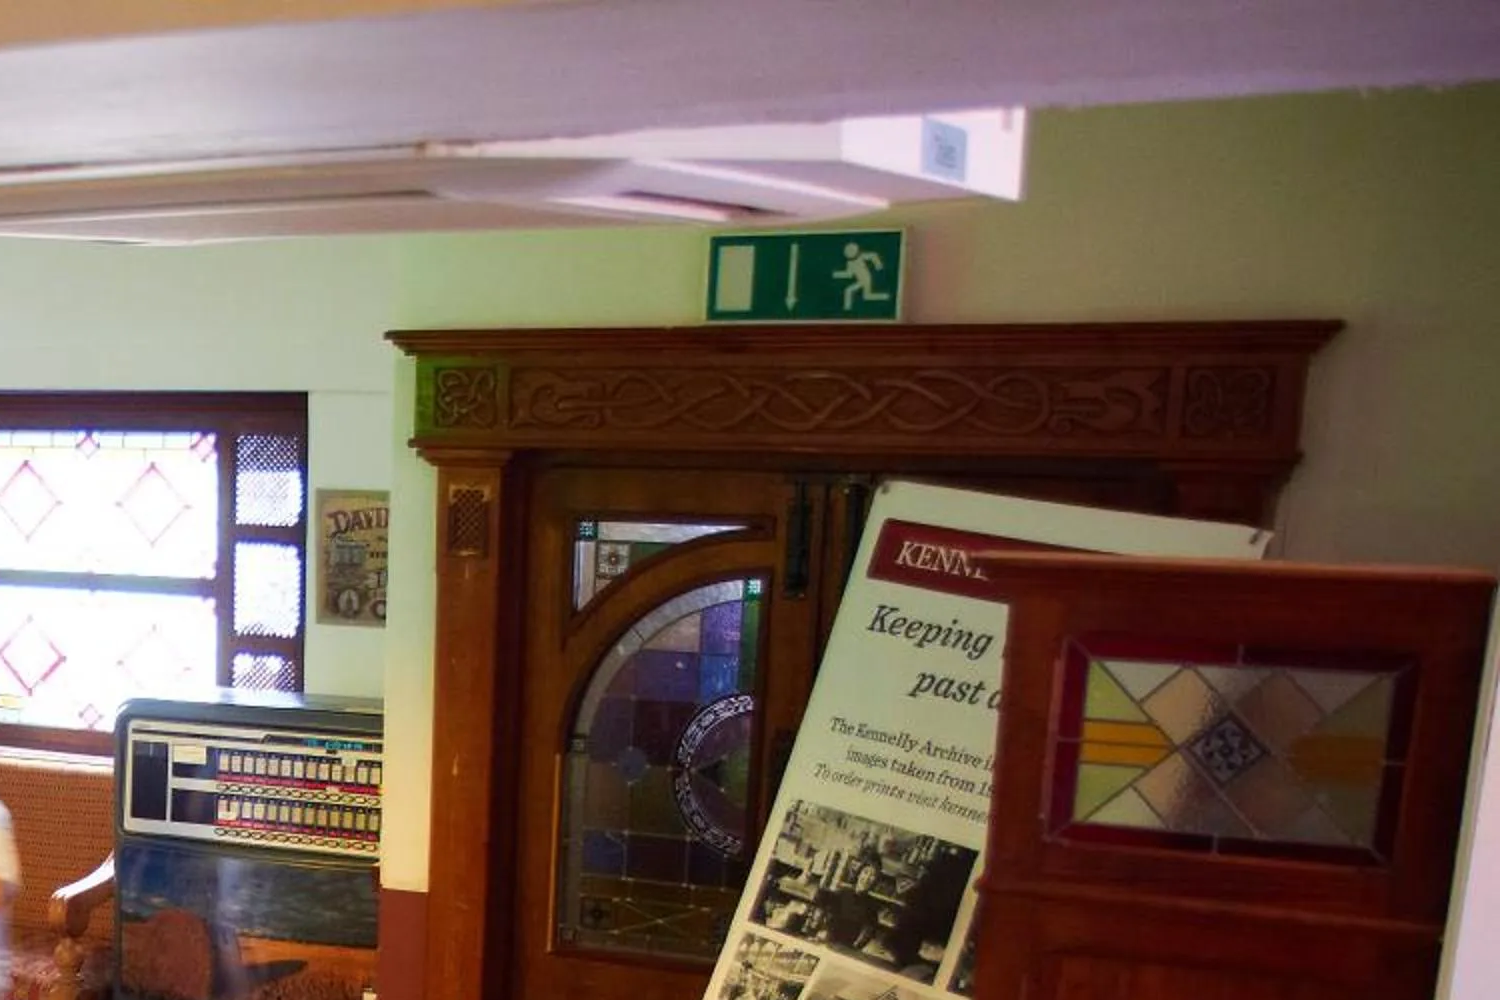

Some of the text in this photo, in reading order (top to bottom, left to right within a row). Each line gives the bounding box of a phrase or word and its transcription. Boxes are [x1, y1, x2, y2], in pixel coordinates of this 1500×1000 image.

[866, 604, 994, 660] Keeping
[908, 672, 986, 705] past
[830, 716, 854, 735] The
[855, 723, 919, 752] Kennelly
[919, 740, 981, 768] Archive
[890, 759, 935, 783] taken
[936, 769, 975, 793] from
